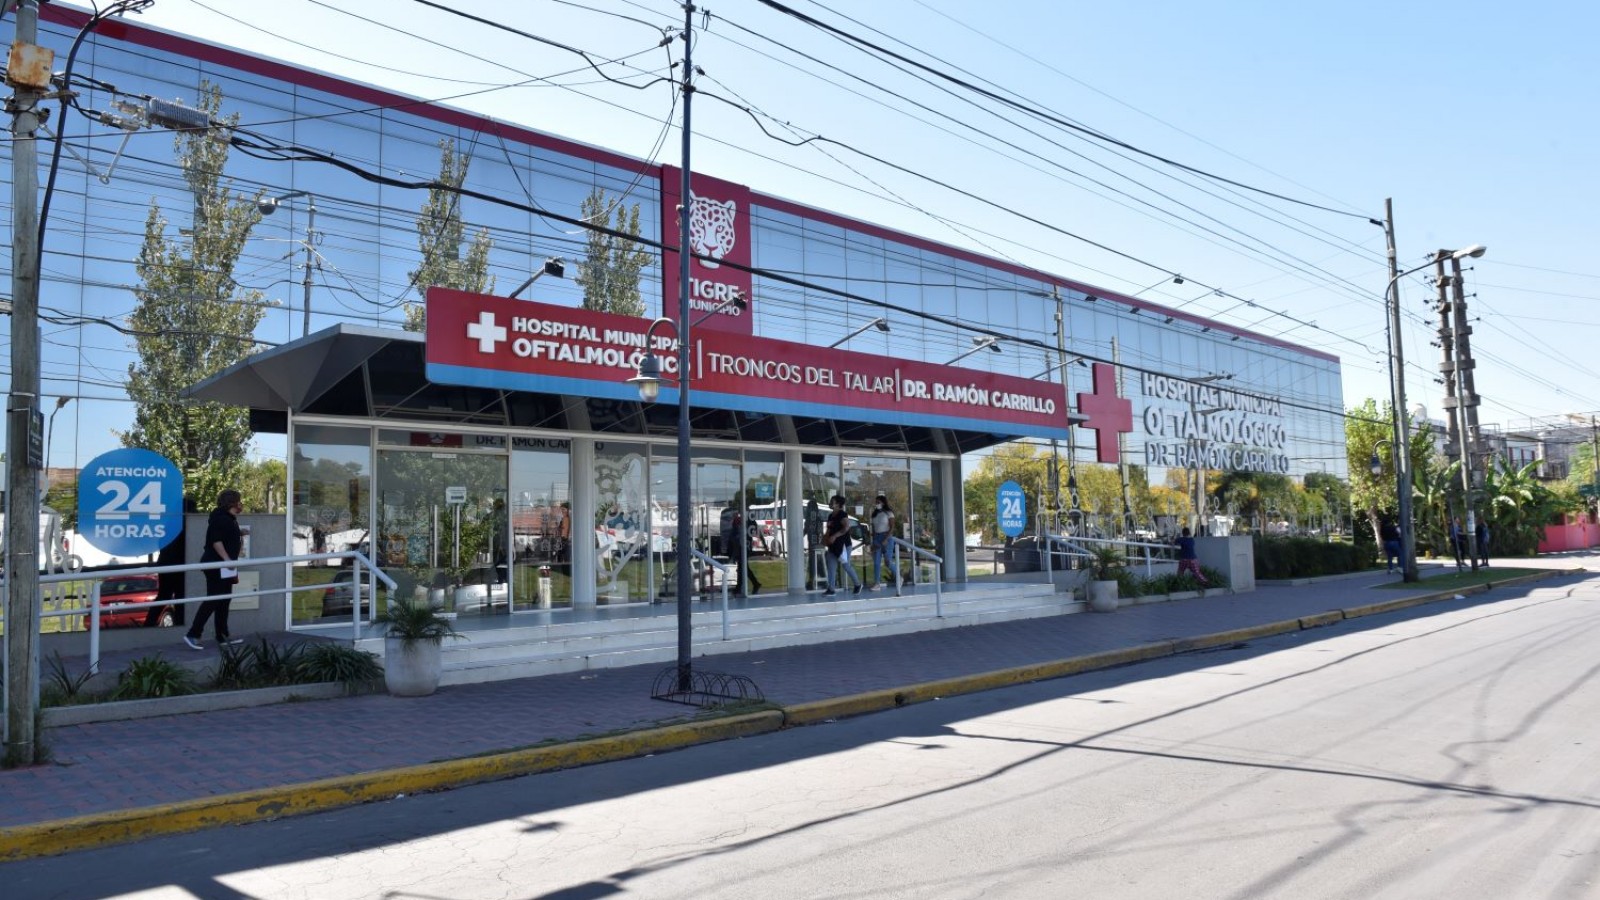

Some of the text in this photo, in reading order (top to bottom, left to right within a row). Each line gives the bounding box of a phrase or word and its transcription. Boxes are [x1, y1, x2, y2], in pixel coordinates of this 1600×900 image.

[512, 316, 601, 343] HOSPITAL
[707, 352, 894, 394] TRONCOS DEL TALAR
[902, 379, 1055, 415] DR. RAMÓN CARRILLO
[1144, 404, 1286, 449] OFTALMOLÓGICO
[96, 466, 166, 478] ATENCIÓN
[1145, 441, 1290, 474] DR. RAMÓN CARRILLO
[95, 480, 166, 520] 24
[1002, 497, 1022, 518] 24
[95, 524, 166, 538] HORAS
[1002, 520, 1023, 528] HORAS
